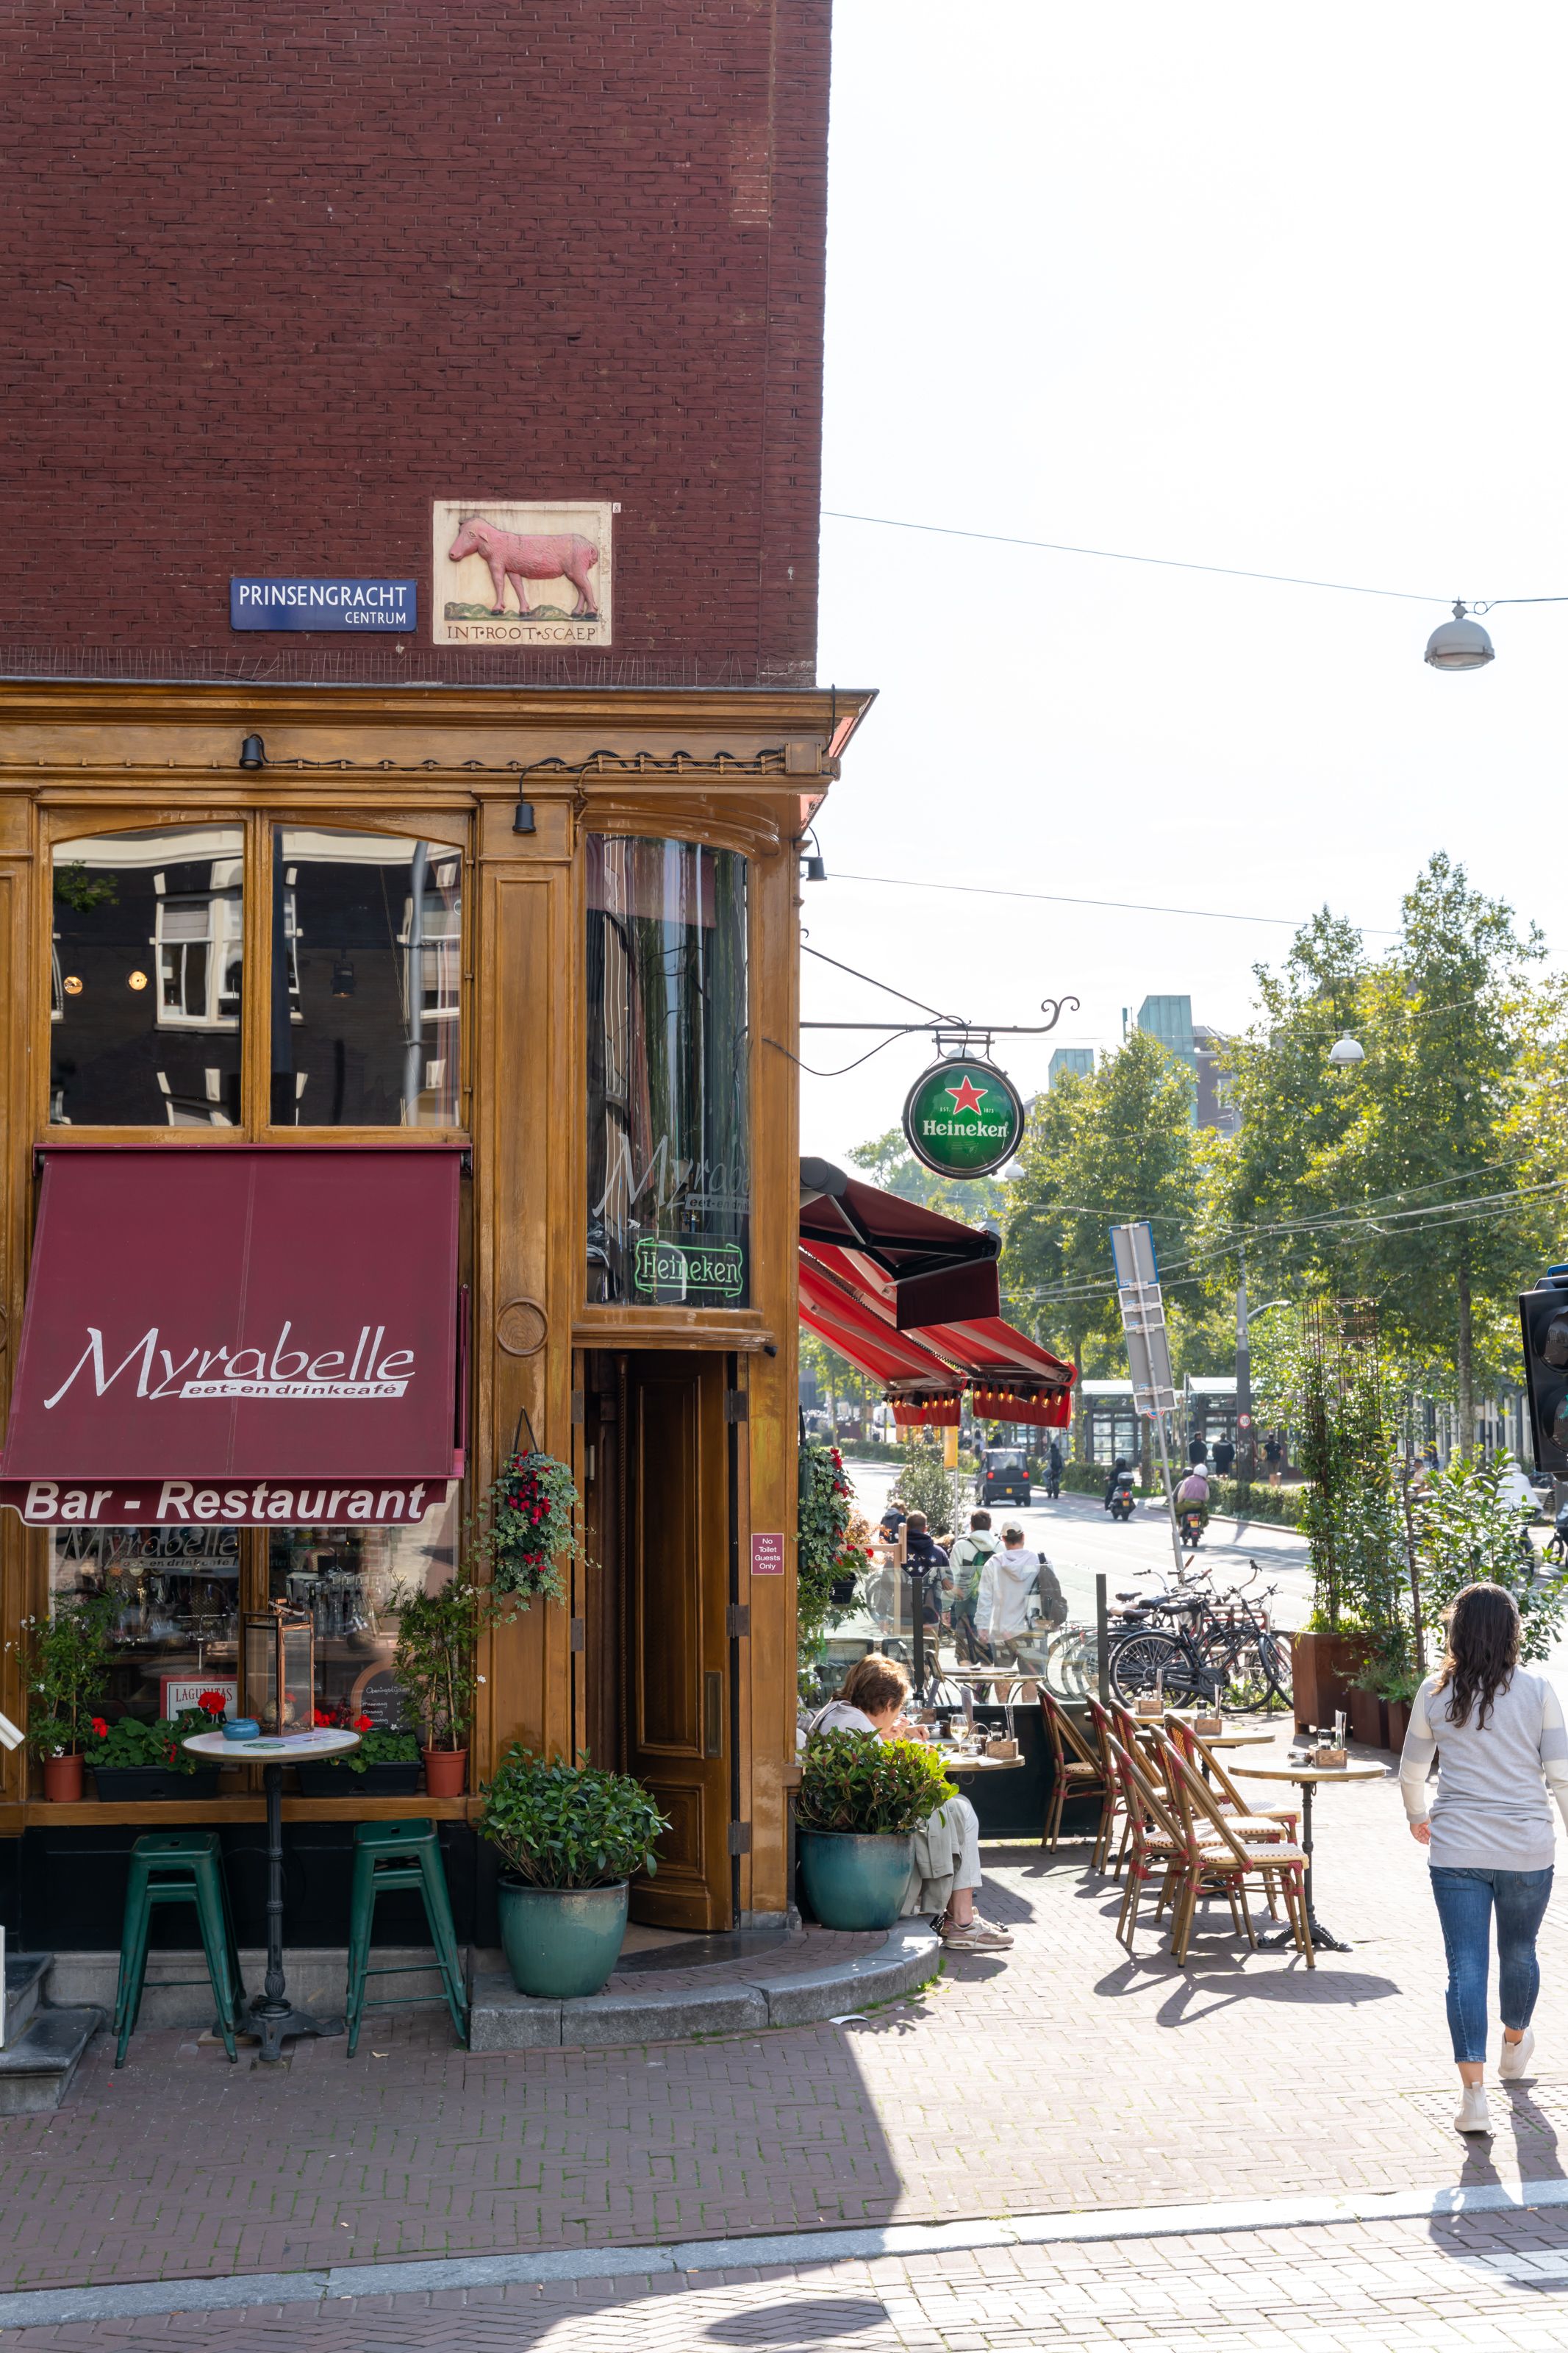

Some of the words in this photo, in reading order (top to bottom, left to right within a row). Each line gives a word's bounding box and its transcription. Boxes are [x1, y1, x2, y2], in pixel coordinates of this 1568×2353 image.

[239, 585, 407, 607] PRINSENGRACHT
[345, 612, 406, 624] CENTRUM
[923, 1120, 1007, 1138] Heineken
[641, 1251, 739, 1283] Heineken
[43, 1321, 415, 1410] Myrabelle
[275, 1384, 397, 1395] drinkcafé
[1121, 1398, 1127, 1407] 2
[24, 1482, 113, 1520] Bar
[157, 1481, 426, 1520] Restaurant
[759, 1563, 776, 1571] Only
[176, 1688, 233, 1702] LAGUAS
